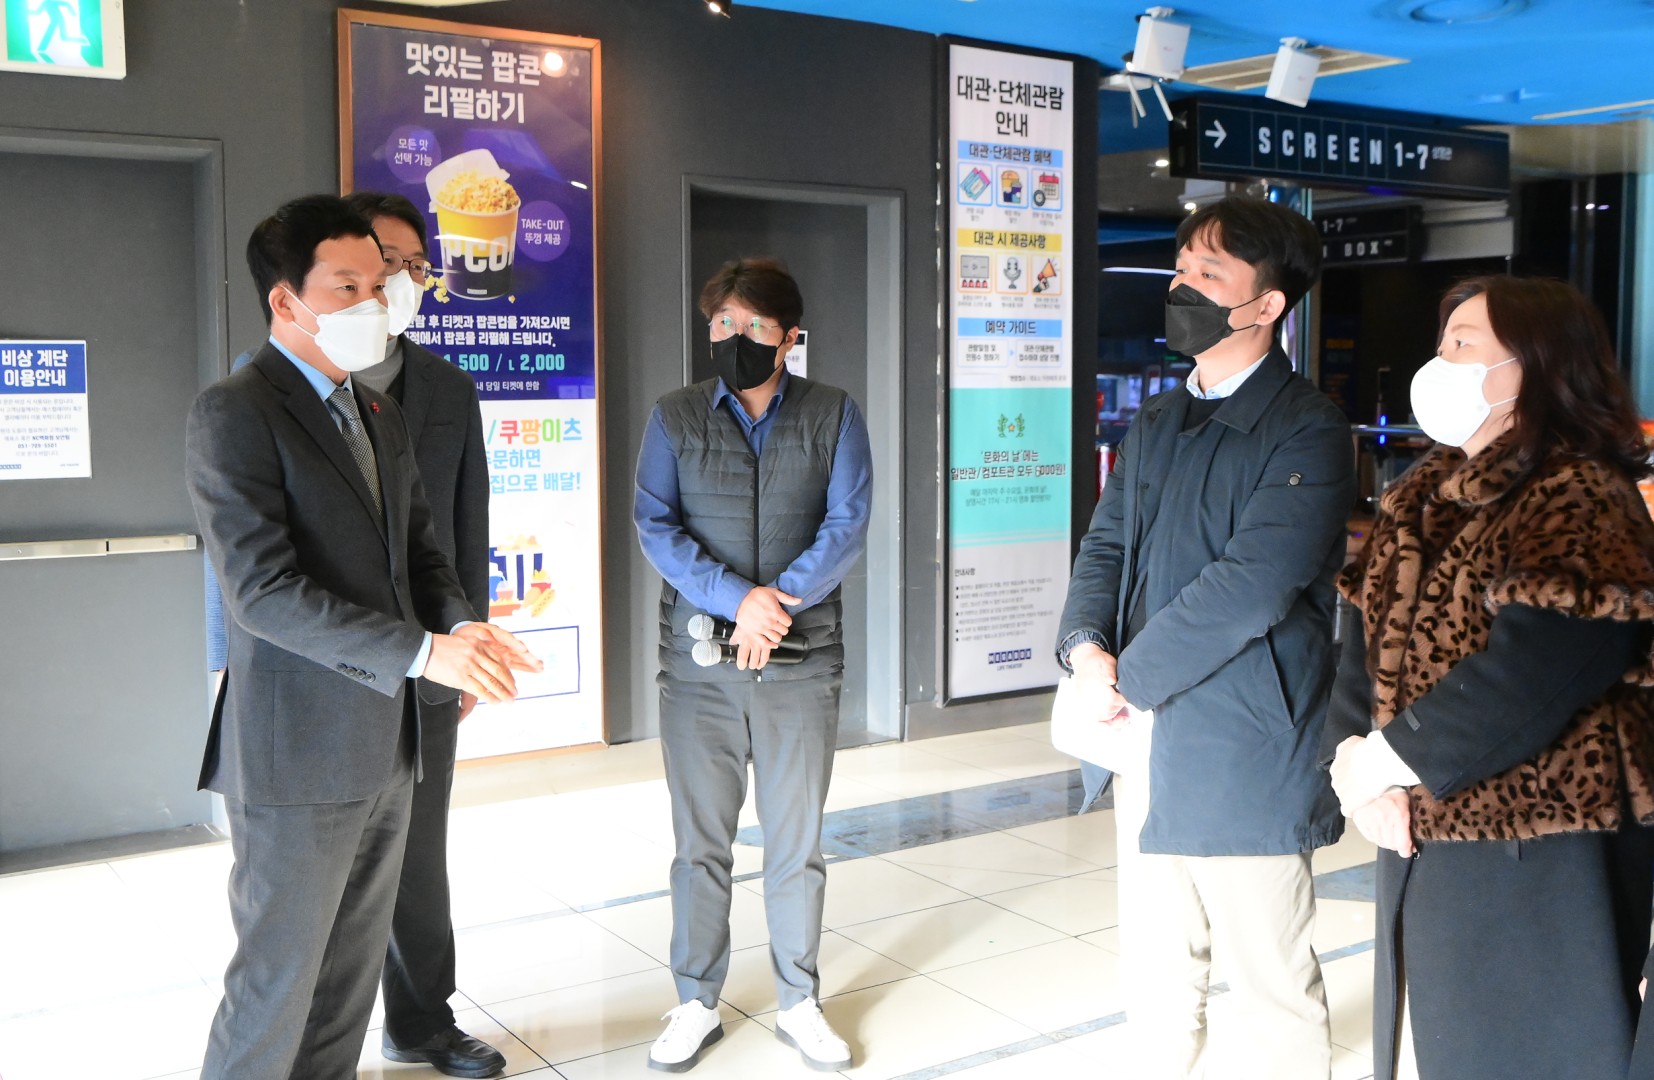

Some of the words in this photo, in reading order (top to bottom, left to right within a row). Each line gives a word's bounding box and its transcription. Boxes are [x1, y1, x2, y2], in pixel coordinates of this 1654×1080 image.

[406, 42, 483, 80] 맛있는
[492, 50, 541, 86] 팝콘
[957, 75, 1064, 111] 대관·단체관람
[424, 85, 525, 123] 리필하기
[996, 111, 1028, 137] 안내
[398, 138, 417, 151] 모든
[419, 139, 429, 152] 맛
[1258, 127, 1383, 165] SCREEN
[1394, 141, 1429, 170] 1-7
[394, 152, 412, 165] 선택
[414, 152, 433, 167] 가능
[1034, 150, 1053, 164] 혜택
[521, 218, 564, 231] TAKE-OUT
[524, 233, 542, 245] 뚜껑
[544, 233, 561, 246] 제공
[974, 232, 994, 245] 대관
[997, 233, 1007, 246] 시
[1010, 233, 1046, 249] 제공사항
[1344, 240, 1379, 257] BOX
[428, 314, 440, 329] 후
[442, 315, 474, 329] 티켓과
[476, 315, 518, 330] 팝콘컵을
[520, 316, 571, 330] 가져오시면
[985, 321, 1006, 333] 예약
[1009, 321, 1036, 334] 가이드
[444, 331, 476, 345] 팝콘을
[478, 332, 510, 346] 리필해
[512, 332, 556, 348] 드립니다.
[1, 349, 33, 367] 비상
[37, 349, 69, 367] 계단
[520, 354, 565, 374] 2,000
[4, 369, 67, 387] 이용안내
[486, 381, 500, 391] 당일
[502, 381, 524, 391] 티켓에
[525, 381, 540, 391] 한함
[1017, 465, 1033, 477] 모두
[490, 474, 538, 494] 집으로
[543, 472, 581, 492] 배달!
